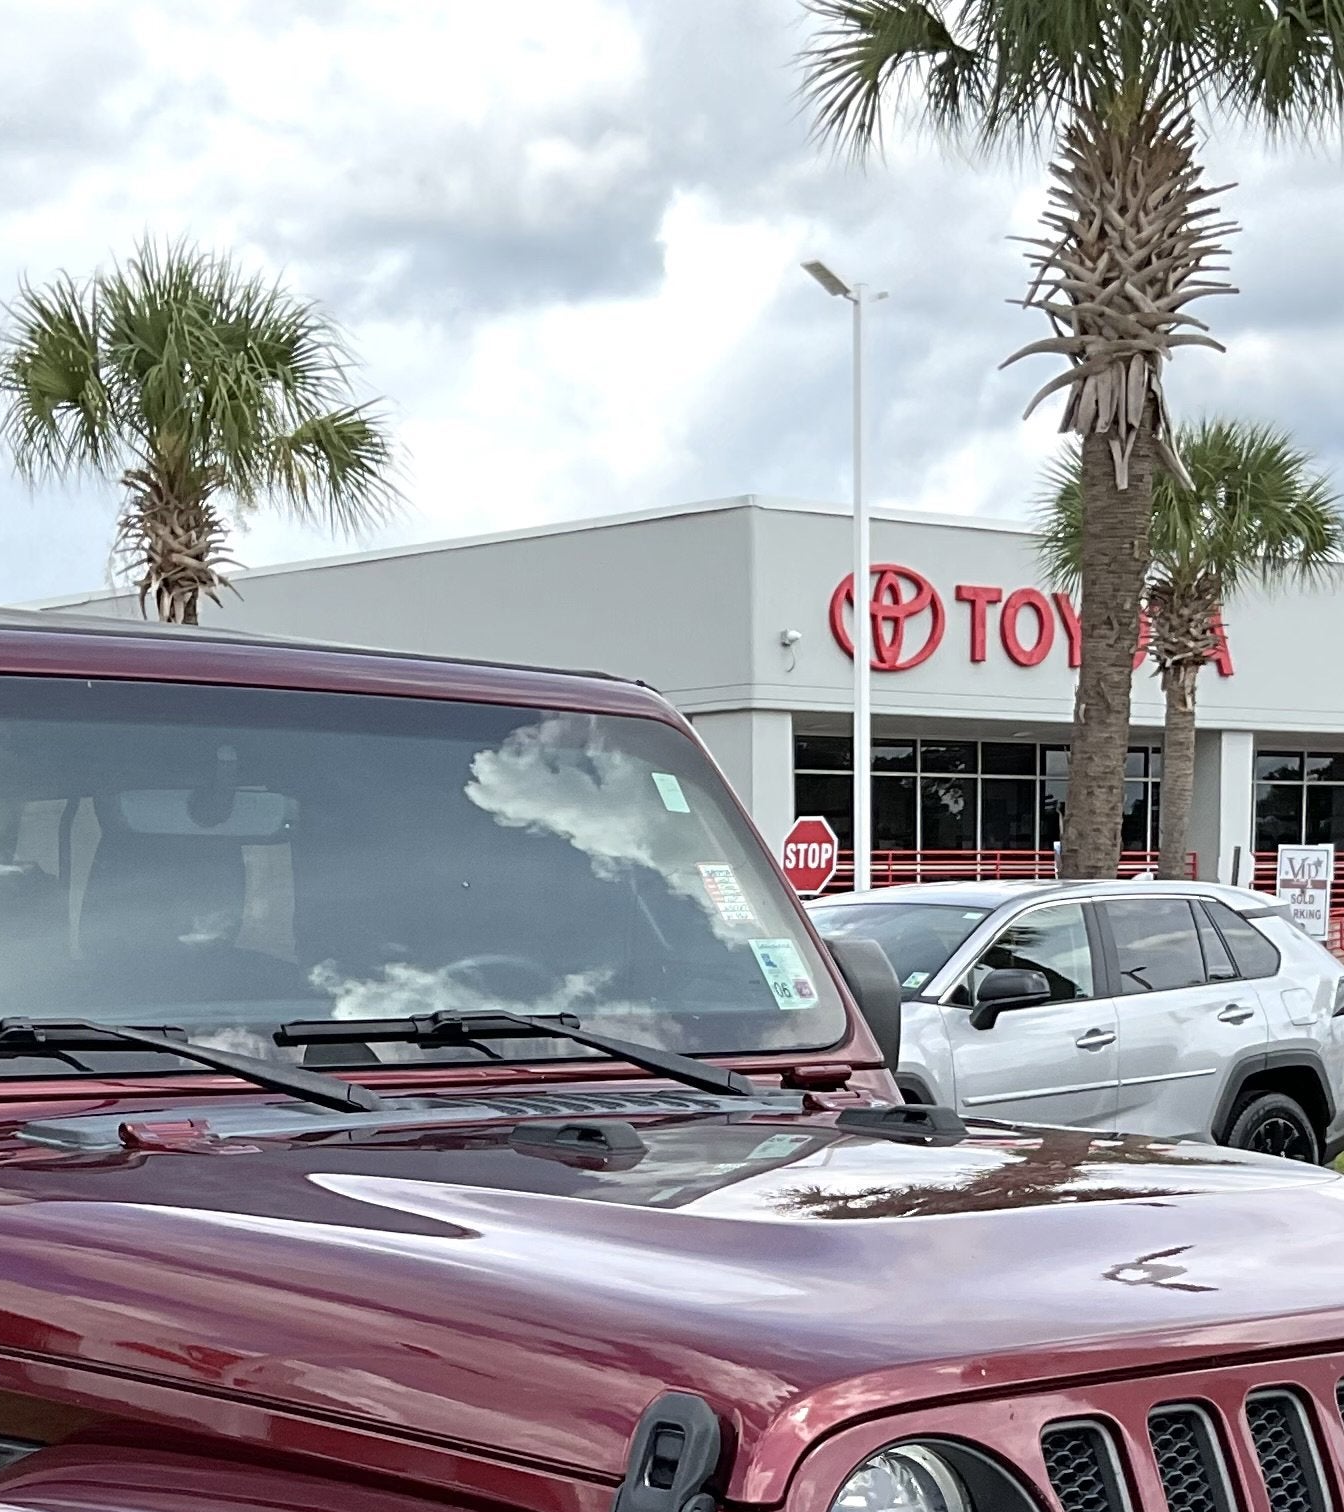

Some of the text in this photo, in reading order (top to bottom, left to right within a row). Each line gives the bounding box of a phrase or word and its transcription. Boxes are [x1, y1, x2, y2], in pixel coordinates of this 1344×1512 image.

[955, 585, 1234, 677] TOY
[785, 842, 832, 869] STOP
[1290, 893, 1315, 905] SOLD
[1293, 908, 1321, 920] RKING
